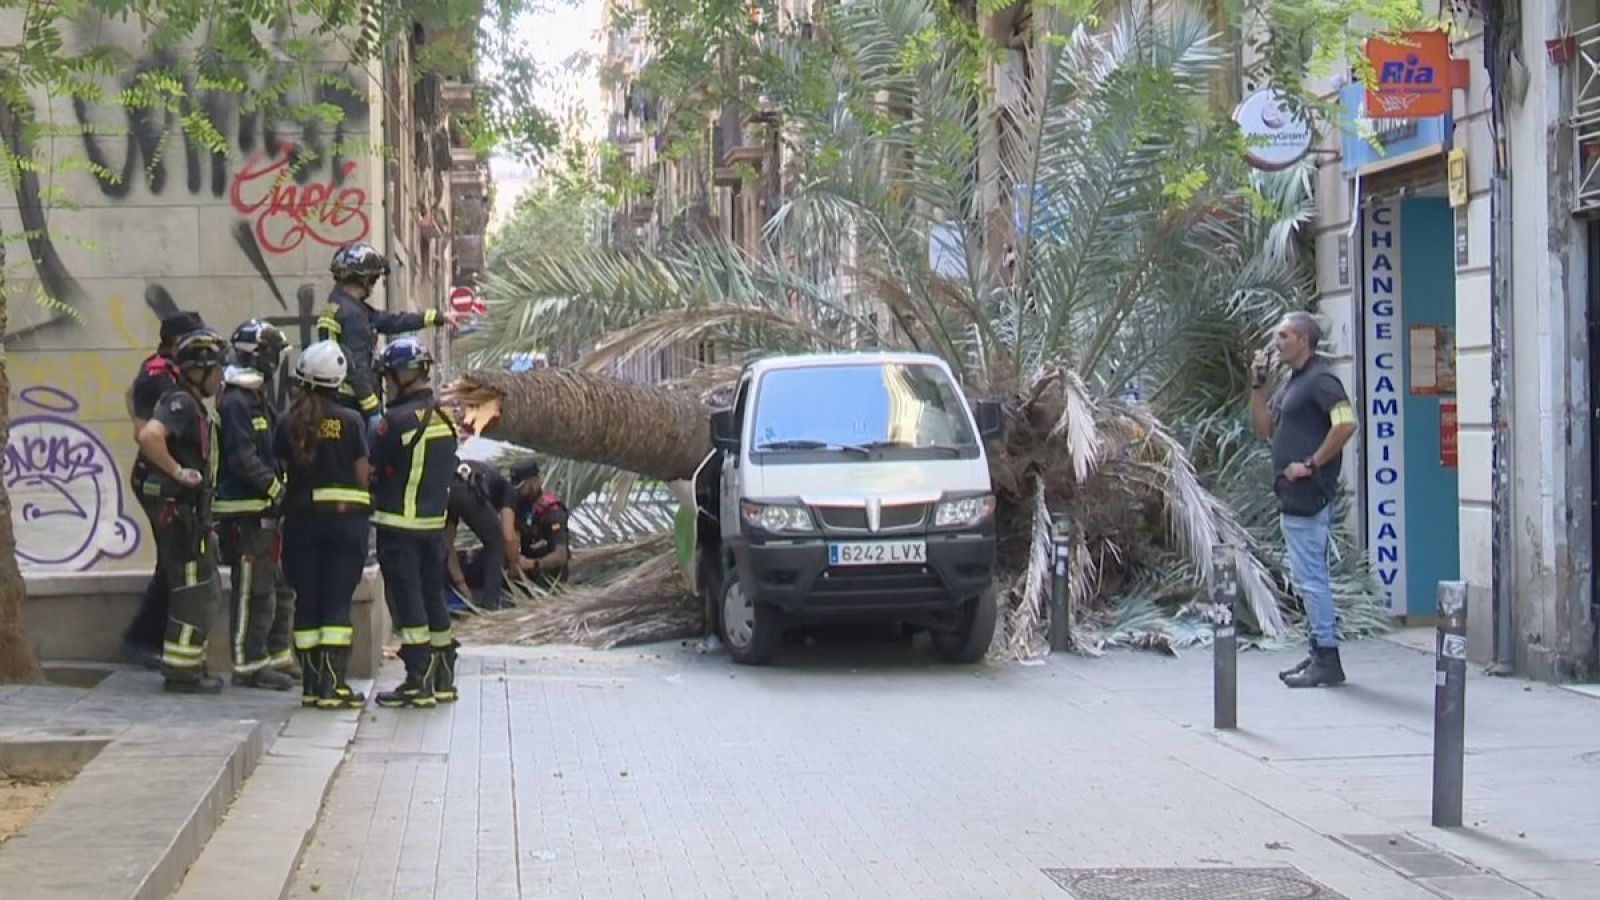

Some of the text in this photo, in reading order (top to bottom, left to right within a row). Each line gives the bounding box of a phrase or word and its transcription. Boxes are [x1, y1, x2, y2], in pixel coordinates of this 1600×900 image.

[1380, 53, 1435, 85] Ria
[1371, 208, 1394, 340] CHANGE
[1372, 353, 1398, 485] CAMBIO
[842, 544, 922, 561] 6242 LVX
